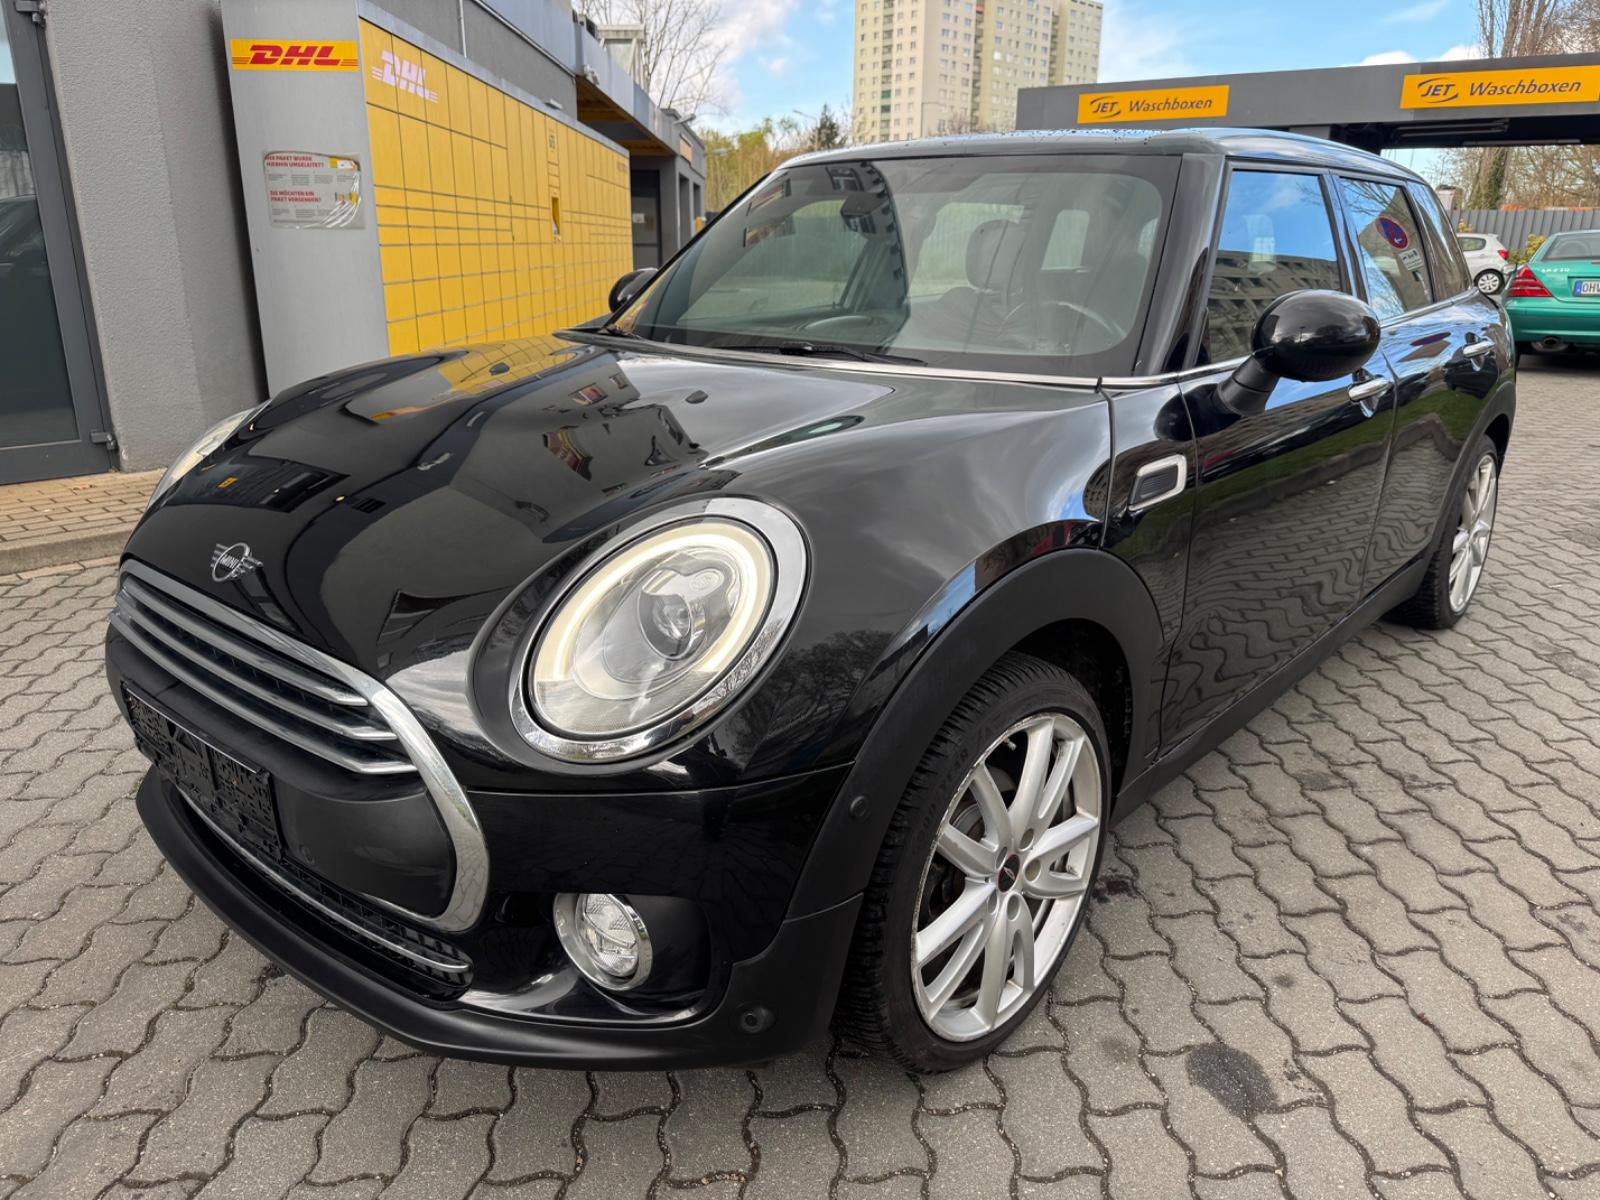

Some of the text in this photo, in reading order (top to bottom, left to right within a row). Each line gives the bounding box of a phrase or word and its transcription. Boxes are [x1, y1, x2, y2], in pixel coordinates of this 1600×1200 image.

[249, 44, 341, 66] DHL
[381, 50, 429, 100] DHL
[1421, 79, 1582, 97] JET Waschboxen
[1092, 98, 1213, 113] JET Waschboxen
[219, 554, 240, 569] MINI
